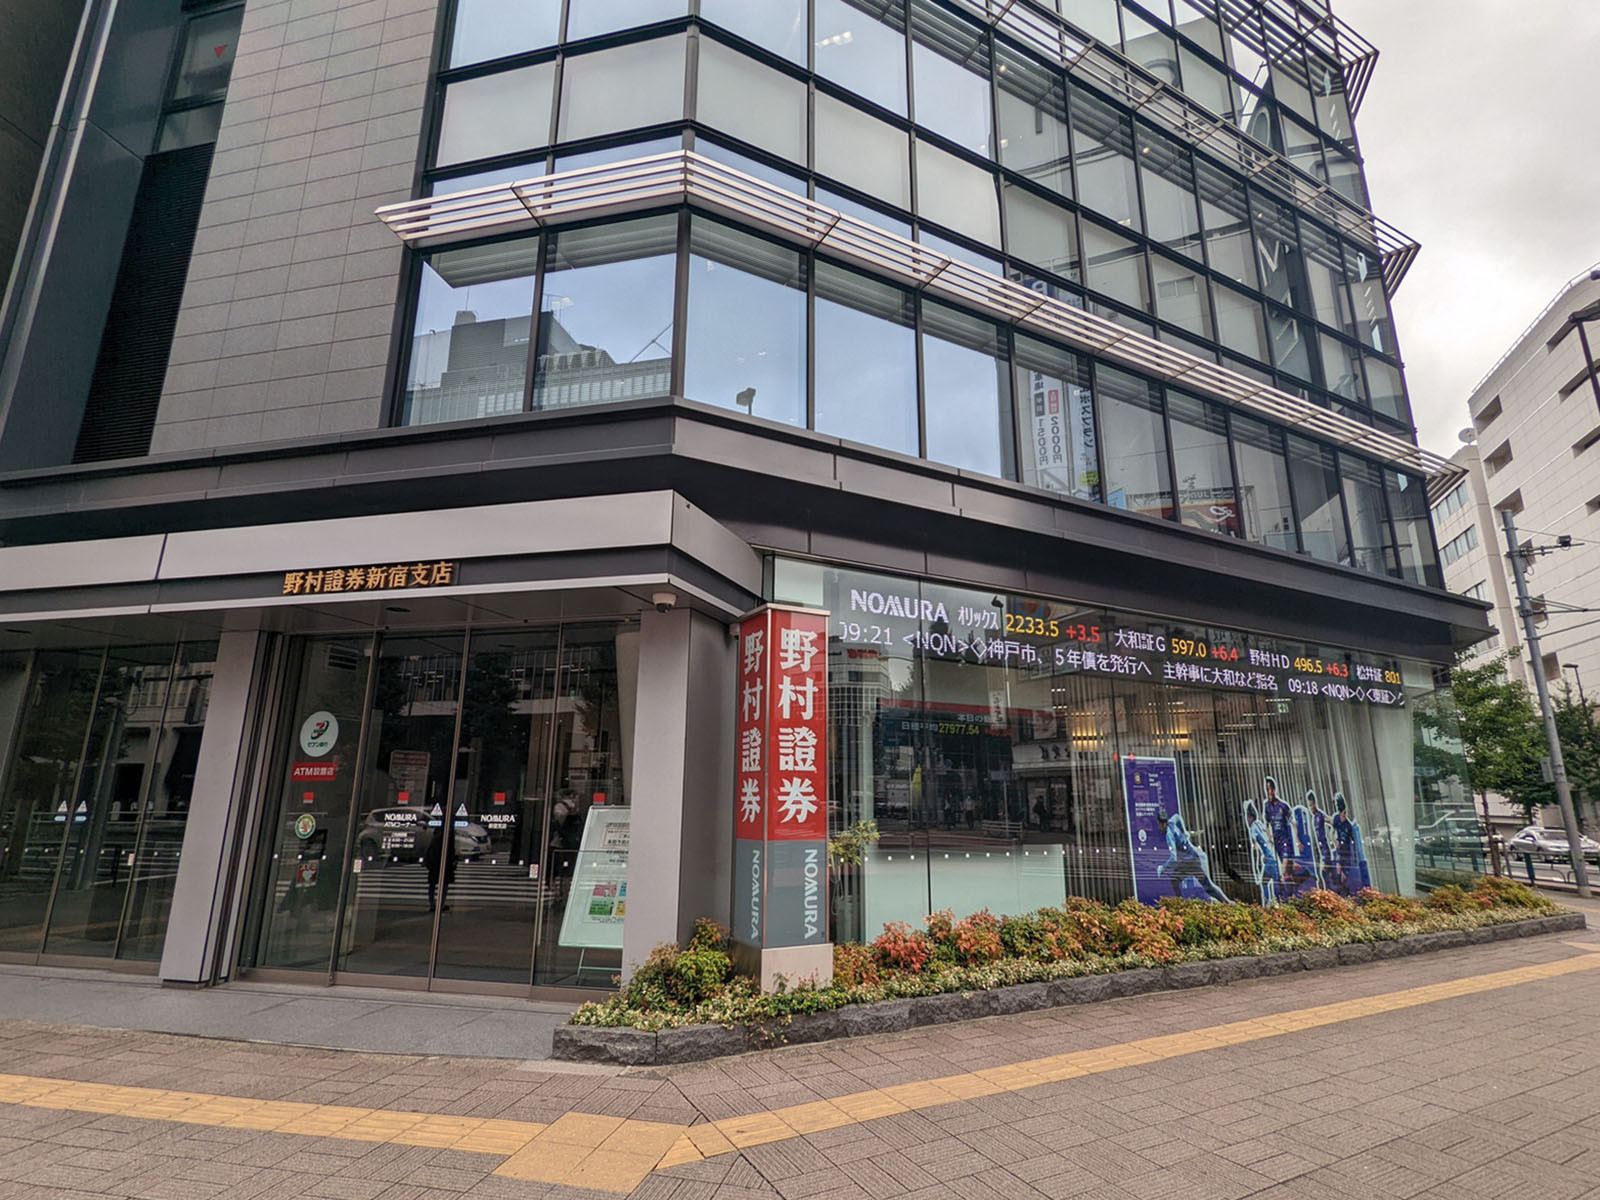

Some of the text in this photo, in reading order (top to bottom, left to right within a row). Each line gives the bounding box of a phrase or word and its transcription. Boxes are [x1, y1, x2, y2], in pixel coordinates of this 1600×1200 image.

[282, 560, 453, 595] 野村證券新宿支店
[850, 589, 949, 624] NOMURA
[1005, 613, 1059, 638] 2233.5
[1066, 624, 1101, 643] +3.5
[1171, 638, 1207, 659] 597.0
[1211, 645, 1238, 662] +6.4
[1249, 648, 1290, 670] 野村HD
[1293, 656, 1323, 674] 496.5
[1326, 662, 1349, 678] +6.3
[1384, 669, 1401, 685] 801
[1163, 662, 1279, 692] 主幹事に大和など指名
[1288, 677, 1319, 696] 09:18
[740, 629, 764, 824] 野村證券
[777, 627, 819, 824] 野村證券
[384, 813, 417, 822] NOMURA
[480, 814, 516, 823] NOMURA
[750, 849, 760, 940] NOMURA
[804, 848, 818, 940] NOMURA
